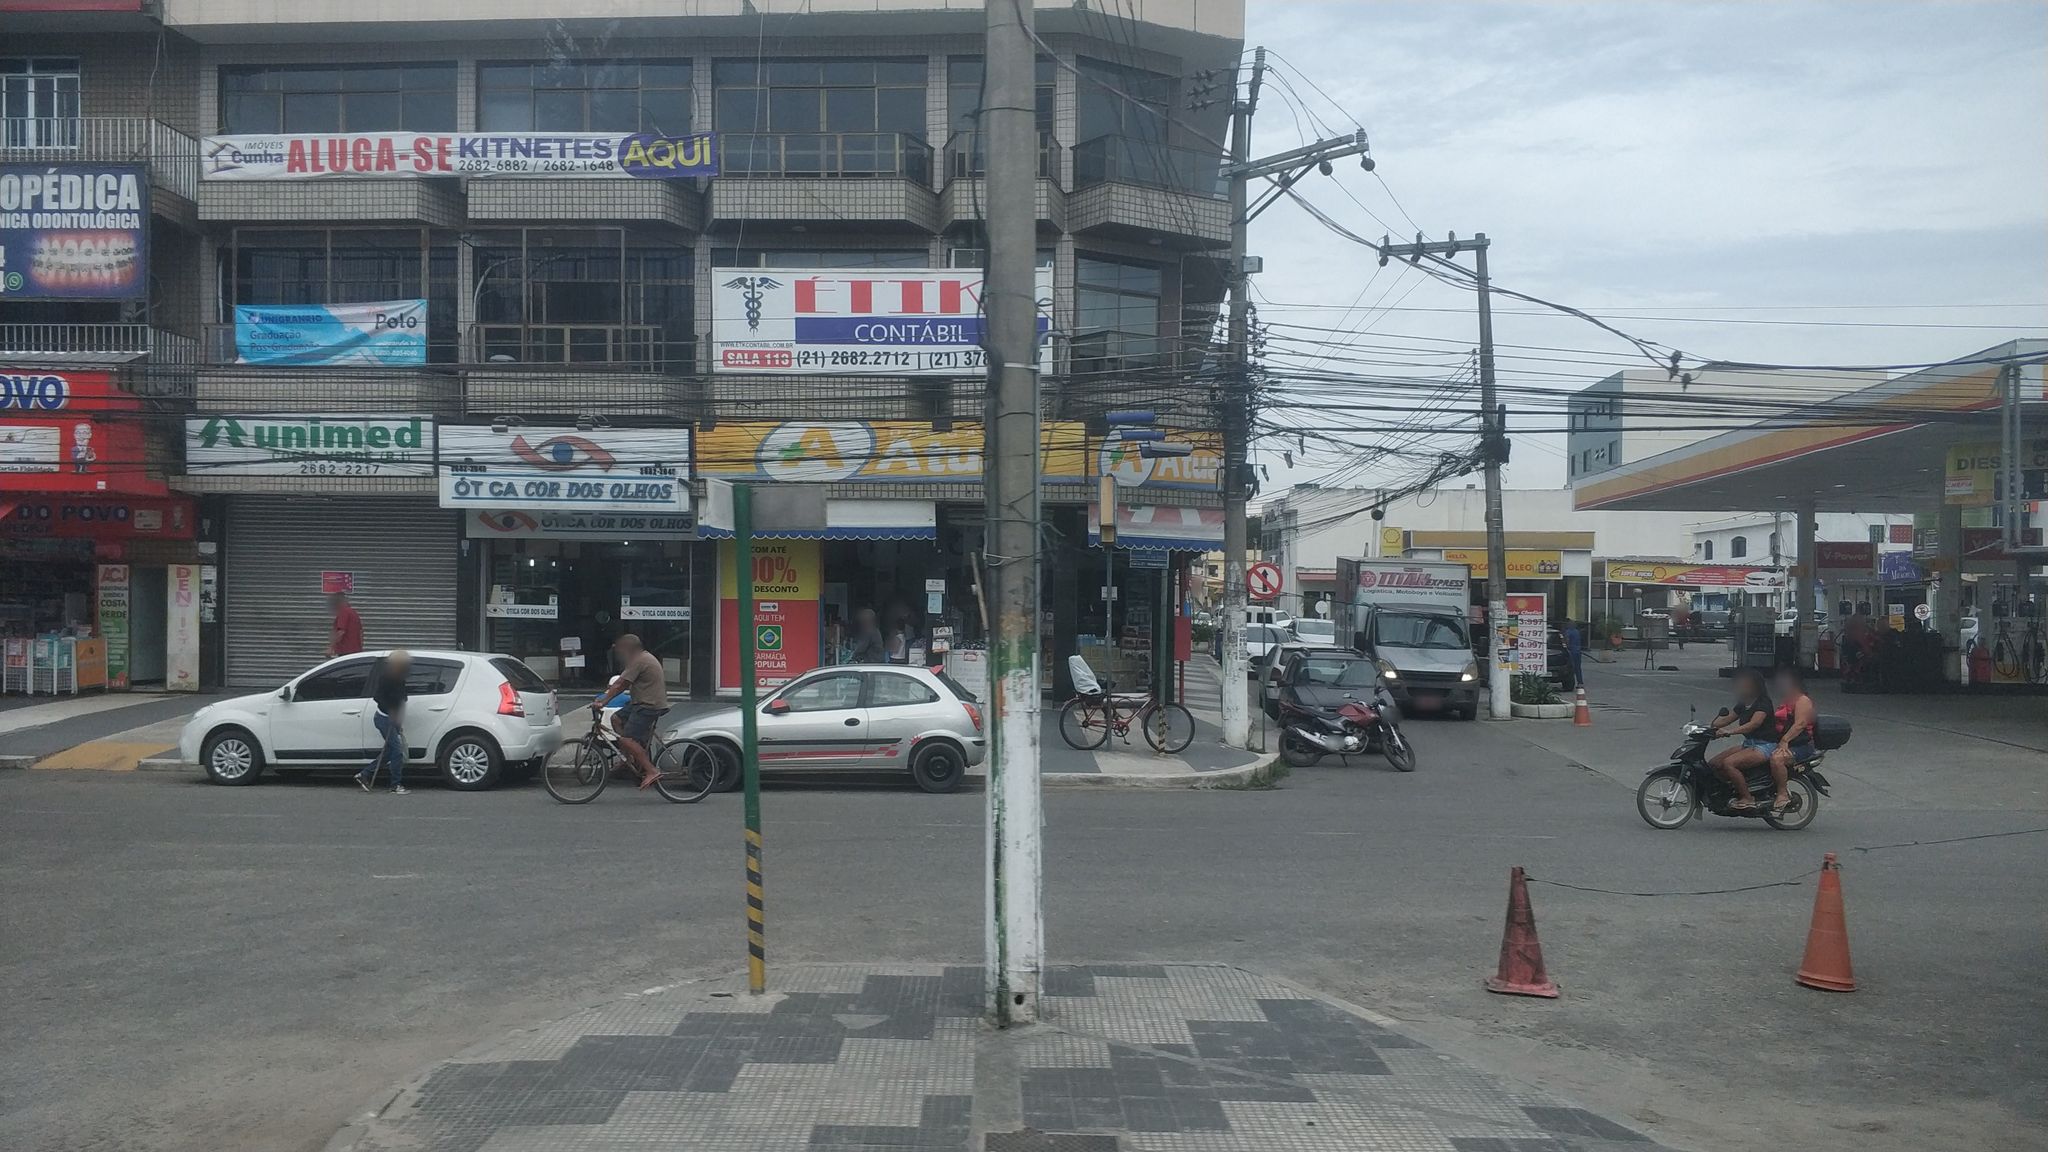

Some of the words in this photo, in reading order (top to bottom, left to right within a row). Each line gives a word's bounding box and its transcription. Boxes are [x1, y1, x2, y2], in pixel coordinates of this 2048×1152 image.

[244, 139, 284, 150] IMÓVEIS
[231, 150, 284, 164] Cunha
[287, 137, 453, 173] ALUGA-SE
[459, 137, 614, 159] KITNETES
[622, 136, 712, 170] AQUI
[458, 160, 529, 172] 2682-6882
[543, 160, 614, 172] 2682-1648
[0, 168, 140, 210] OPÉDICA
[32, 210, 140, 229] ODONTOLÓGICA
[375, 313, 418, 330] Polo
[250, 330, 302, 341] Graduação
[854, 321, 969, 343] CONTÁBIL
[727, 352, 760, 365] SALA
[796, 350, 826, 368] (21)
[831, 351, 909, 366] 2682.2712
[928, 351, 958, 369] (21)
[254, 416, 422, 448] unimed
[876, 439, 983, 473] Atu
[300, 464, 380, 474] 2682-2217
[524, 481, 560, 497] COR
[566, 482, 604, 498] DOS
[610, 483, 673, 499] OLHOS
[754, 585, 799, 594] DESCONTO
[1424, 579, 1465, 588] EXPRESS
[772, 614, 785, 622] TEM
